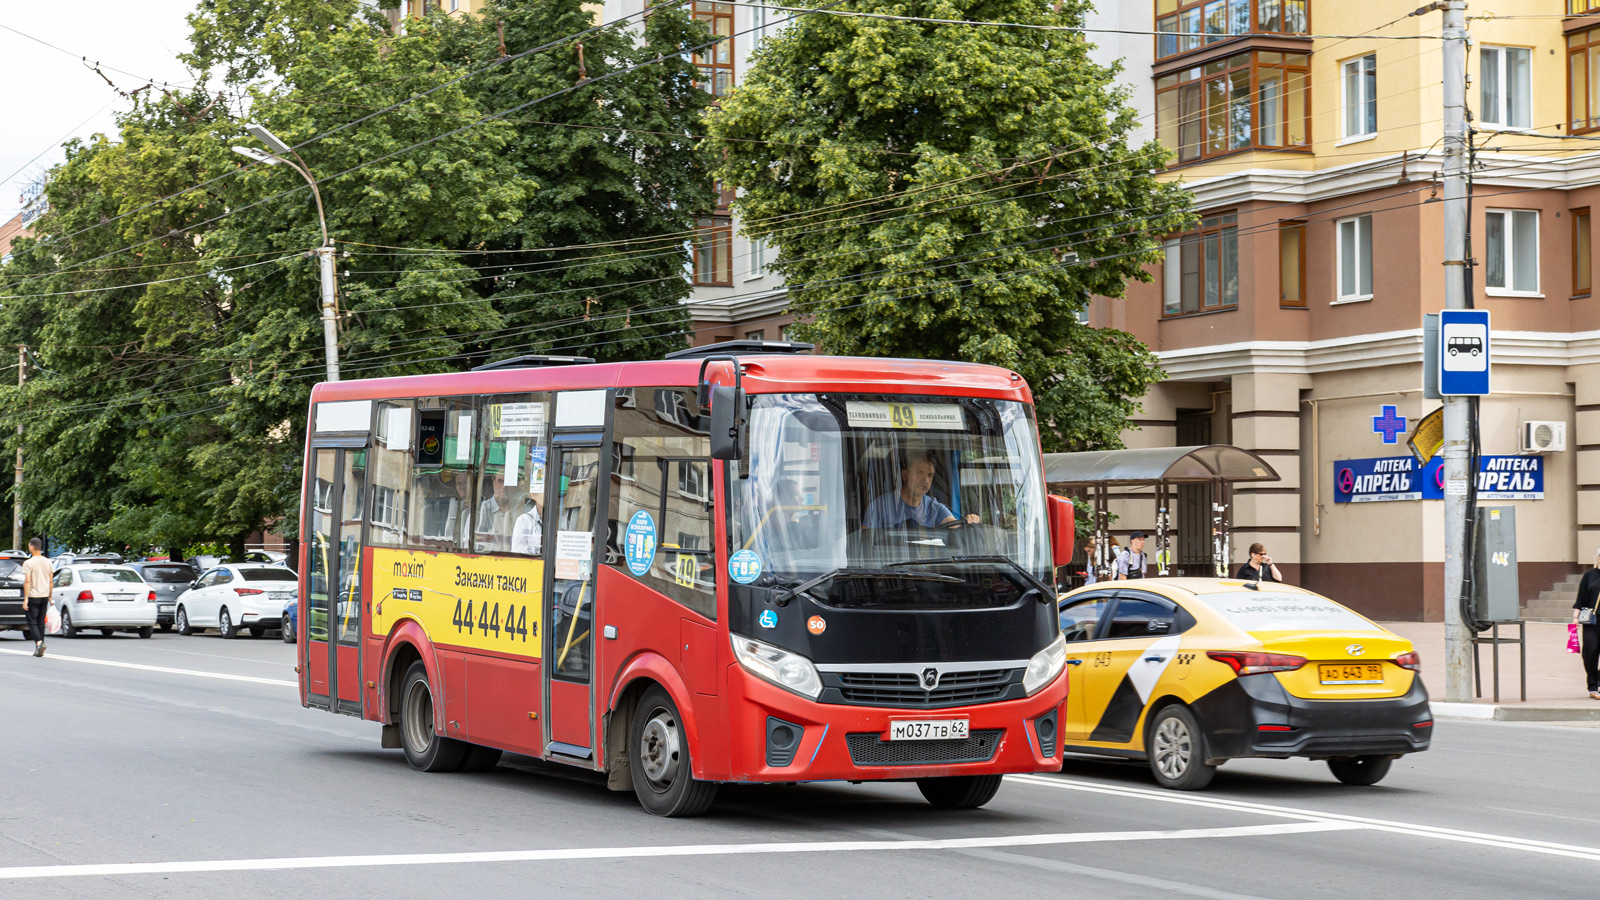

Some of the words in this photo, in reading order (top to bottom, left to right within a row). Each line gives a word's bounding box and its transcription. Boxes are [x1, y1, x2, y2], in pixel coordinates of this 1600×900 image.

[892, 405, 914, 427] 49
[1373, 458, 1412, 473] АПТЕКА
[1486, 458, 1538, 471] АПТЕКА
[1352, 473, 1410, 493] АПРЕЛЬ
[455, 565, 494, 590] Закажи
[496, 575, 527, 593] такси
[678, 558, 694, 588] 49
[810, 620, 824, 629] 50
[1094, 652, 1112, 667] 643
[1342, 666, 1363, 679] 643
[951, 721, 964, 733] 62
